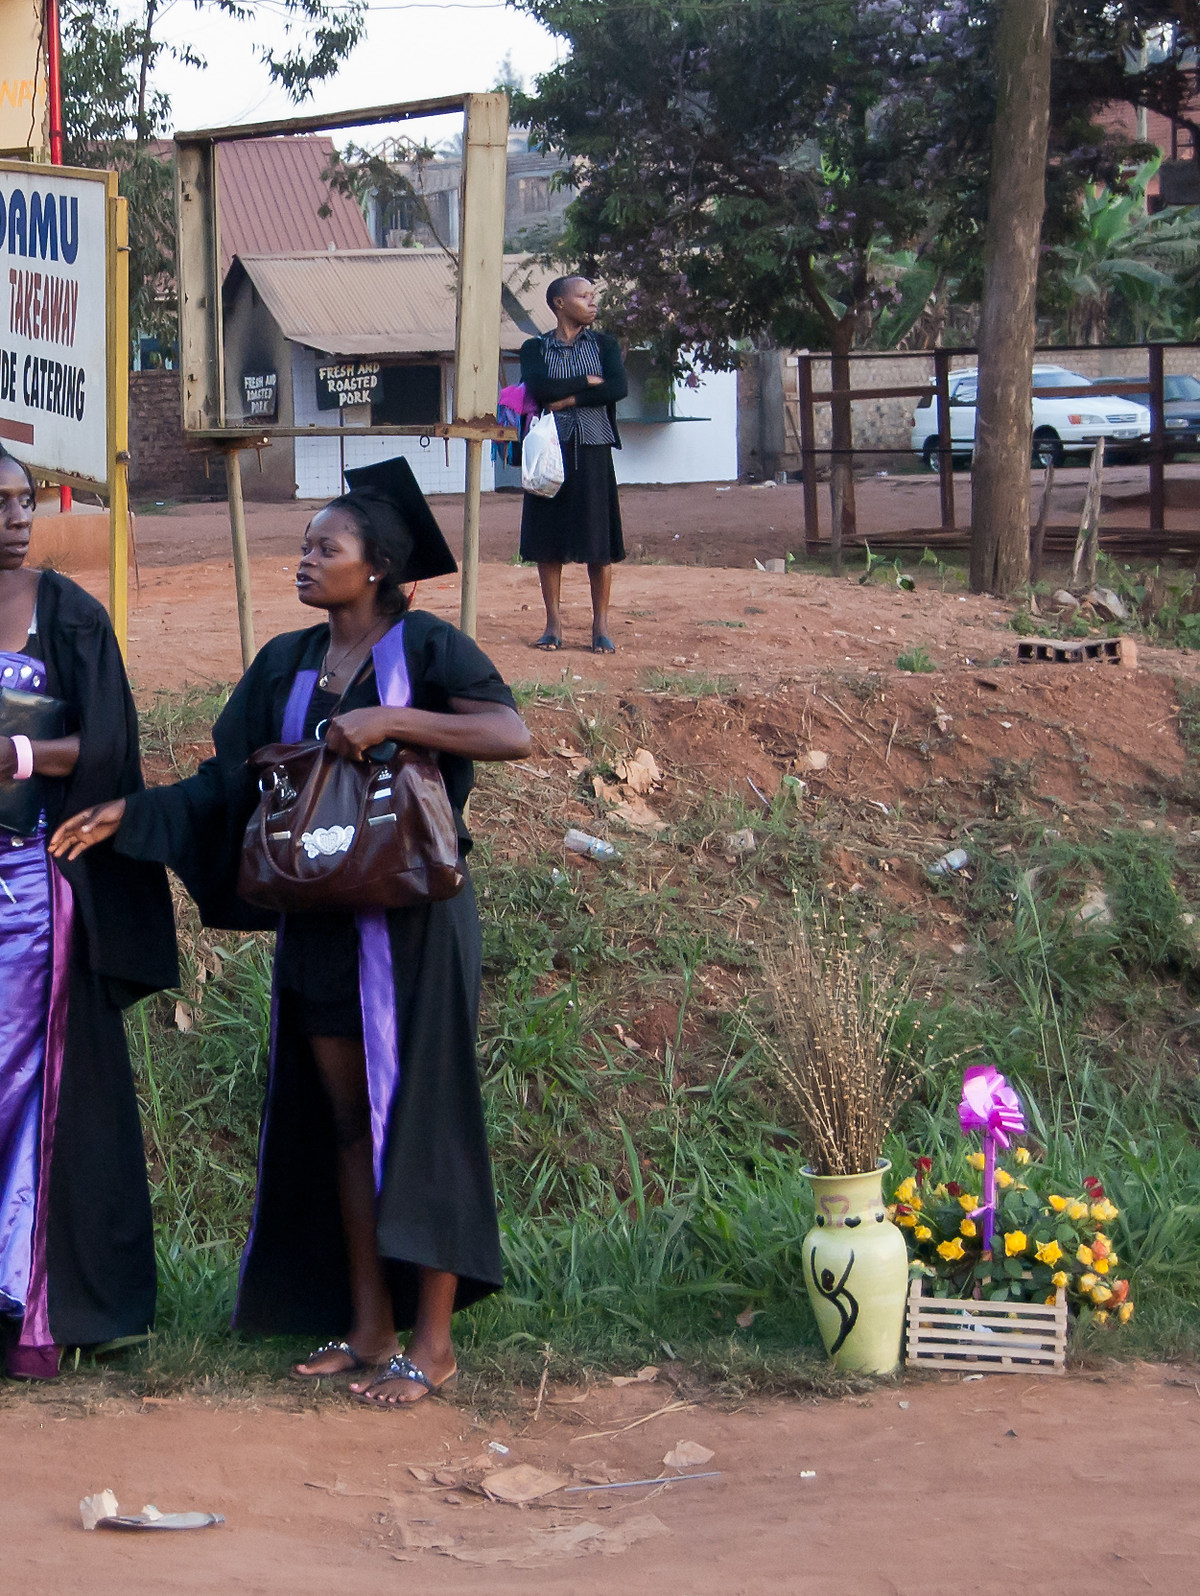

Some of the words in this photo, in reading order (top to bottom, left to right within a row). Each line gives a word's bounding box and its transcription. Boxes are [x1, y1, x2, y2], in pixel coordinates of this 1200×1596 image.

[8, 267, 79, 348] TAKEAWAY
[318, 364, 355, 380] FRESH
[357, 361, 381, 376] AND
[23, 354, 86, 423] CATERING
[327, 375, 378, 393] ROASTED
[338, 389, 372, 407] PORK
